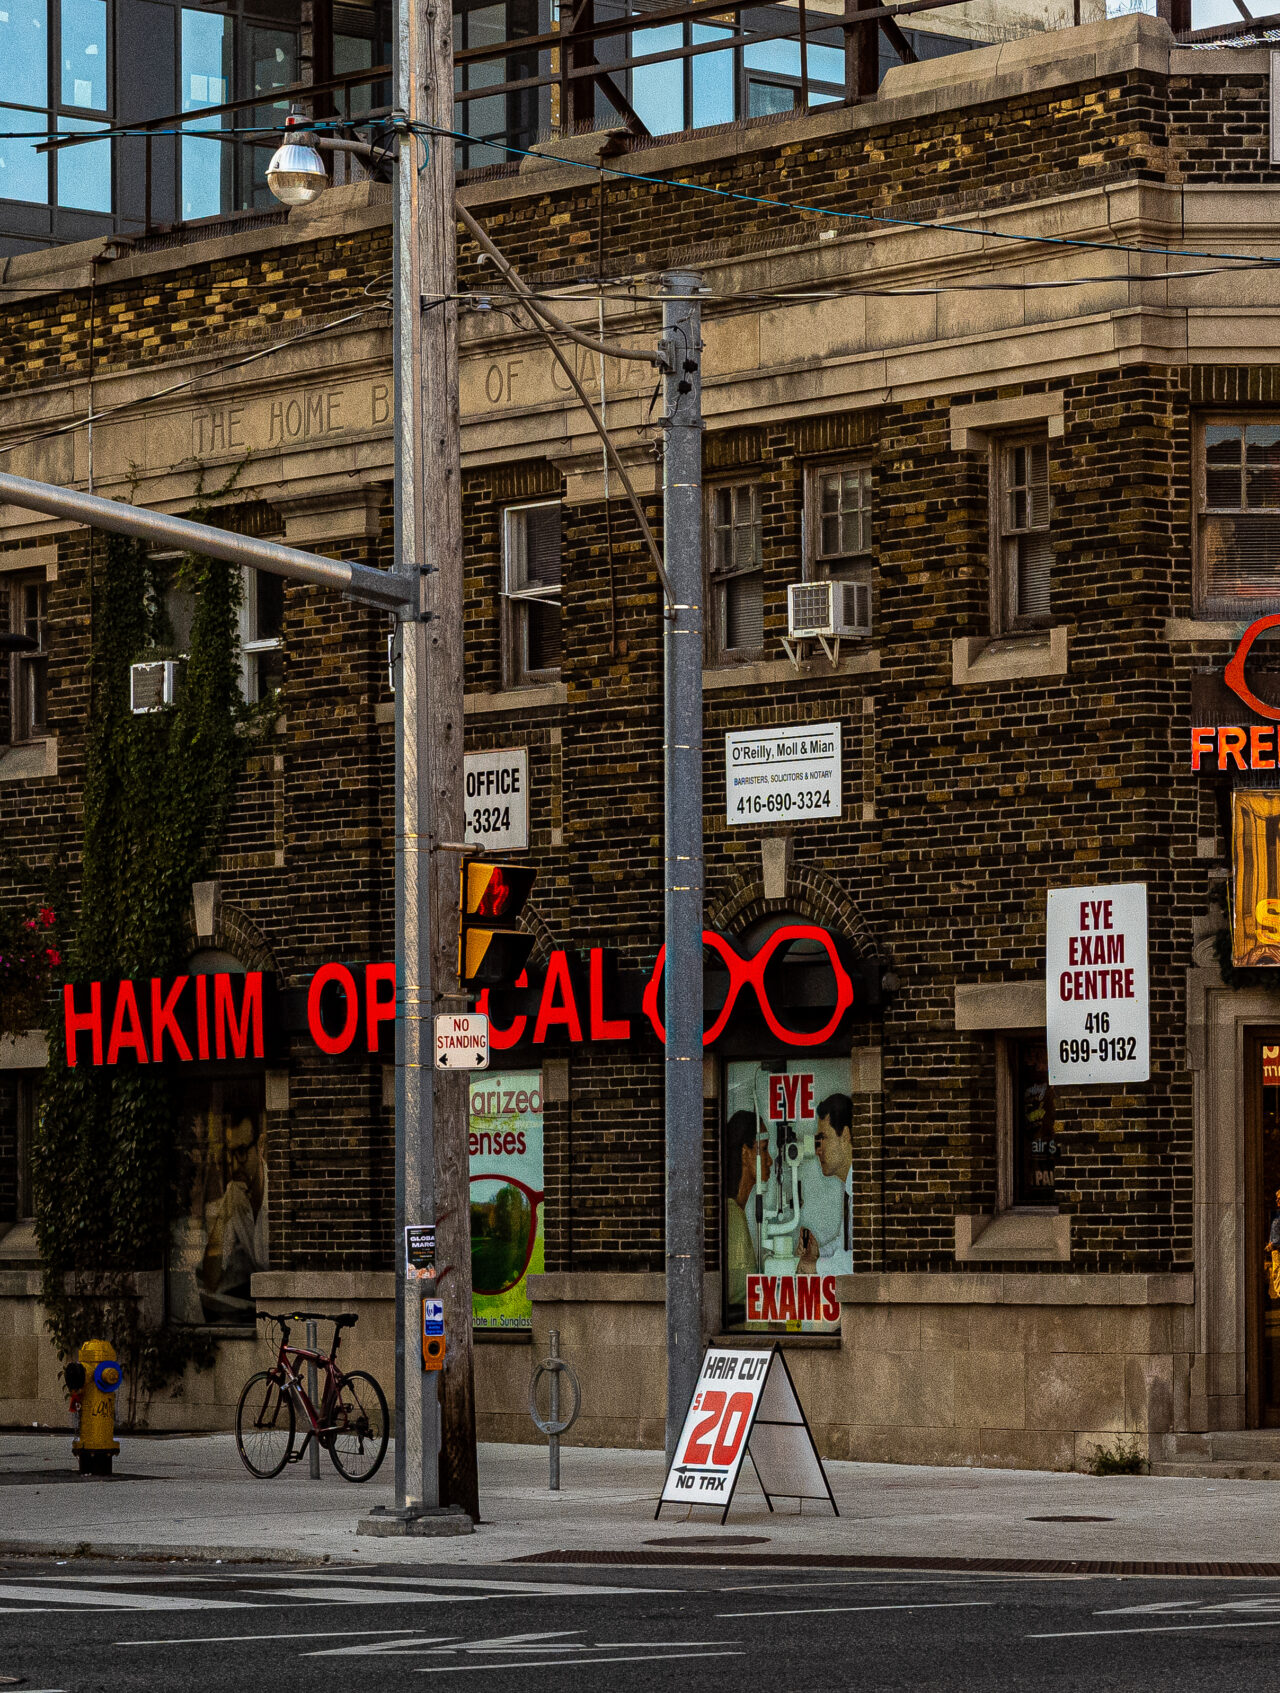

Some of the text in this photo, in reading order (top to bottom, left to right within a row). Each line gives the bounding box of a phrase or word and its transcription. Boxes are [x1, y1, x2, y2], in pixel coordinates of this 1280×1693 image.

[485, 359, 524, 404] OF
[191, 407, 245, 453] THE
[268, 391, 345, 442] HOME
[732, 740, 835, 761] O'Reilly, Moll & Mian
[466, 767, 520, 798] OFFICE
[733, 769, 833, 787] BARRISTERS, SOLICITORS & NOTARY
[736, 789, 831, 814] 416-690-3324
[463, 806, 511, 834] -3324
[1079, 899, 1114, 931] EYE
[1068, 933, 1125, 966] EXAM
[1059, 968, 1135, 1002] CENTRE
[63, 947, 632, 1068] HAKIM OPCAL
[453, 1018, 470, 1032] NO
[1084, 1011, 1110, 1034] 416
[437, 1035, 487, 1049] STANDING
[1059, 1036, 1137, 1064] 699-9132
[769, 1073, 815, 1120] EYE
[747, 1275, 841, 1322] EXAMS
[703, 1356, 769, 1381] HAIR CUT
[682, 1390, 754, 1466] $20
[675, 1474, 728, 1491] NO TAX
